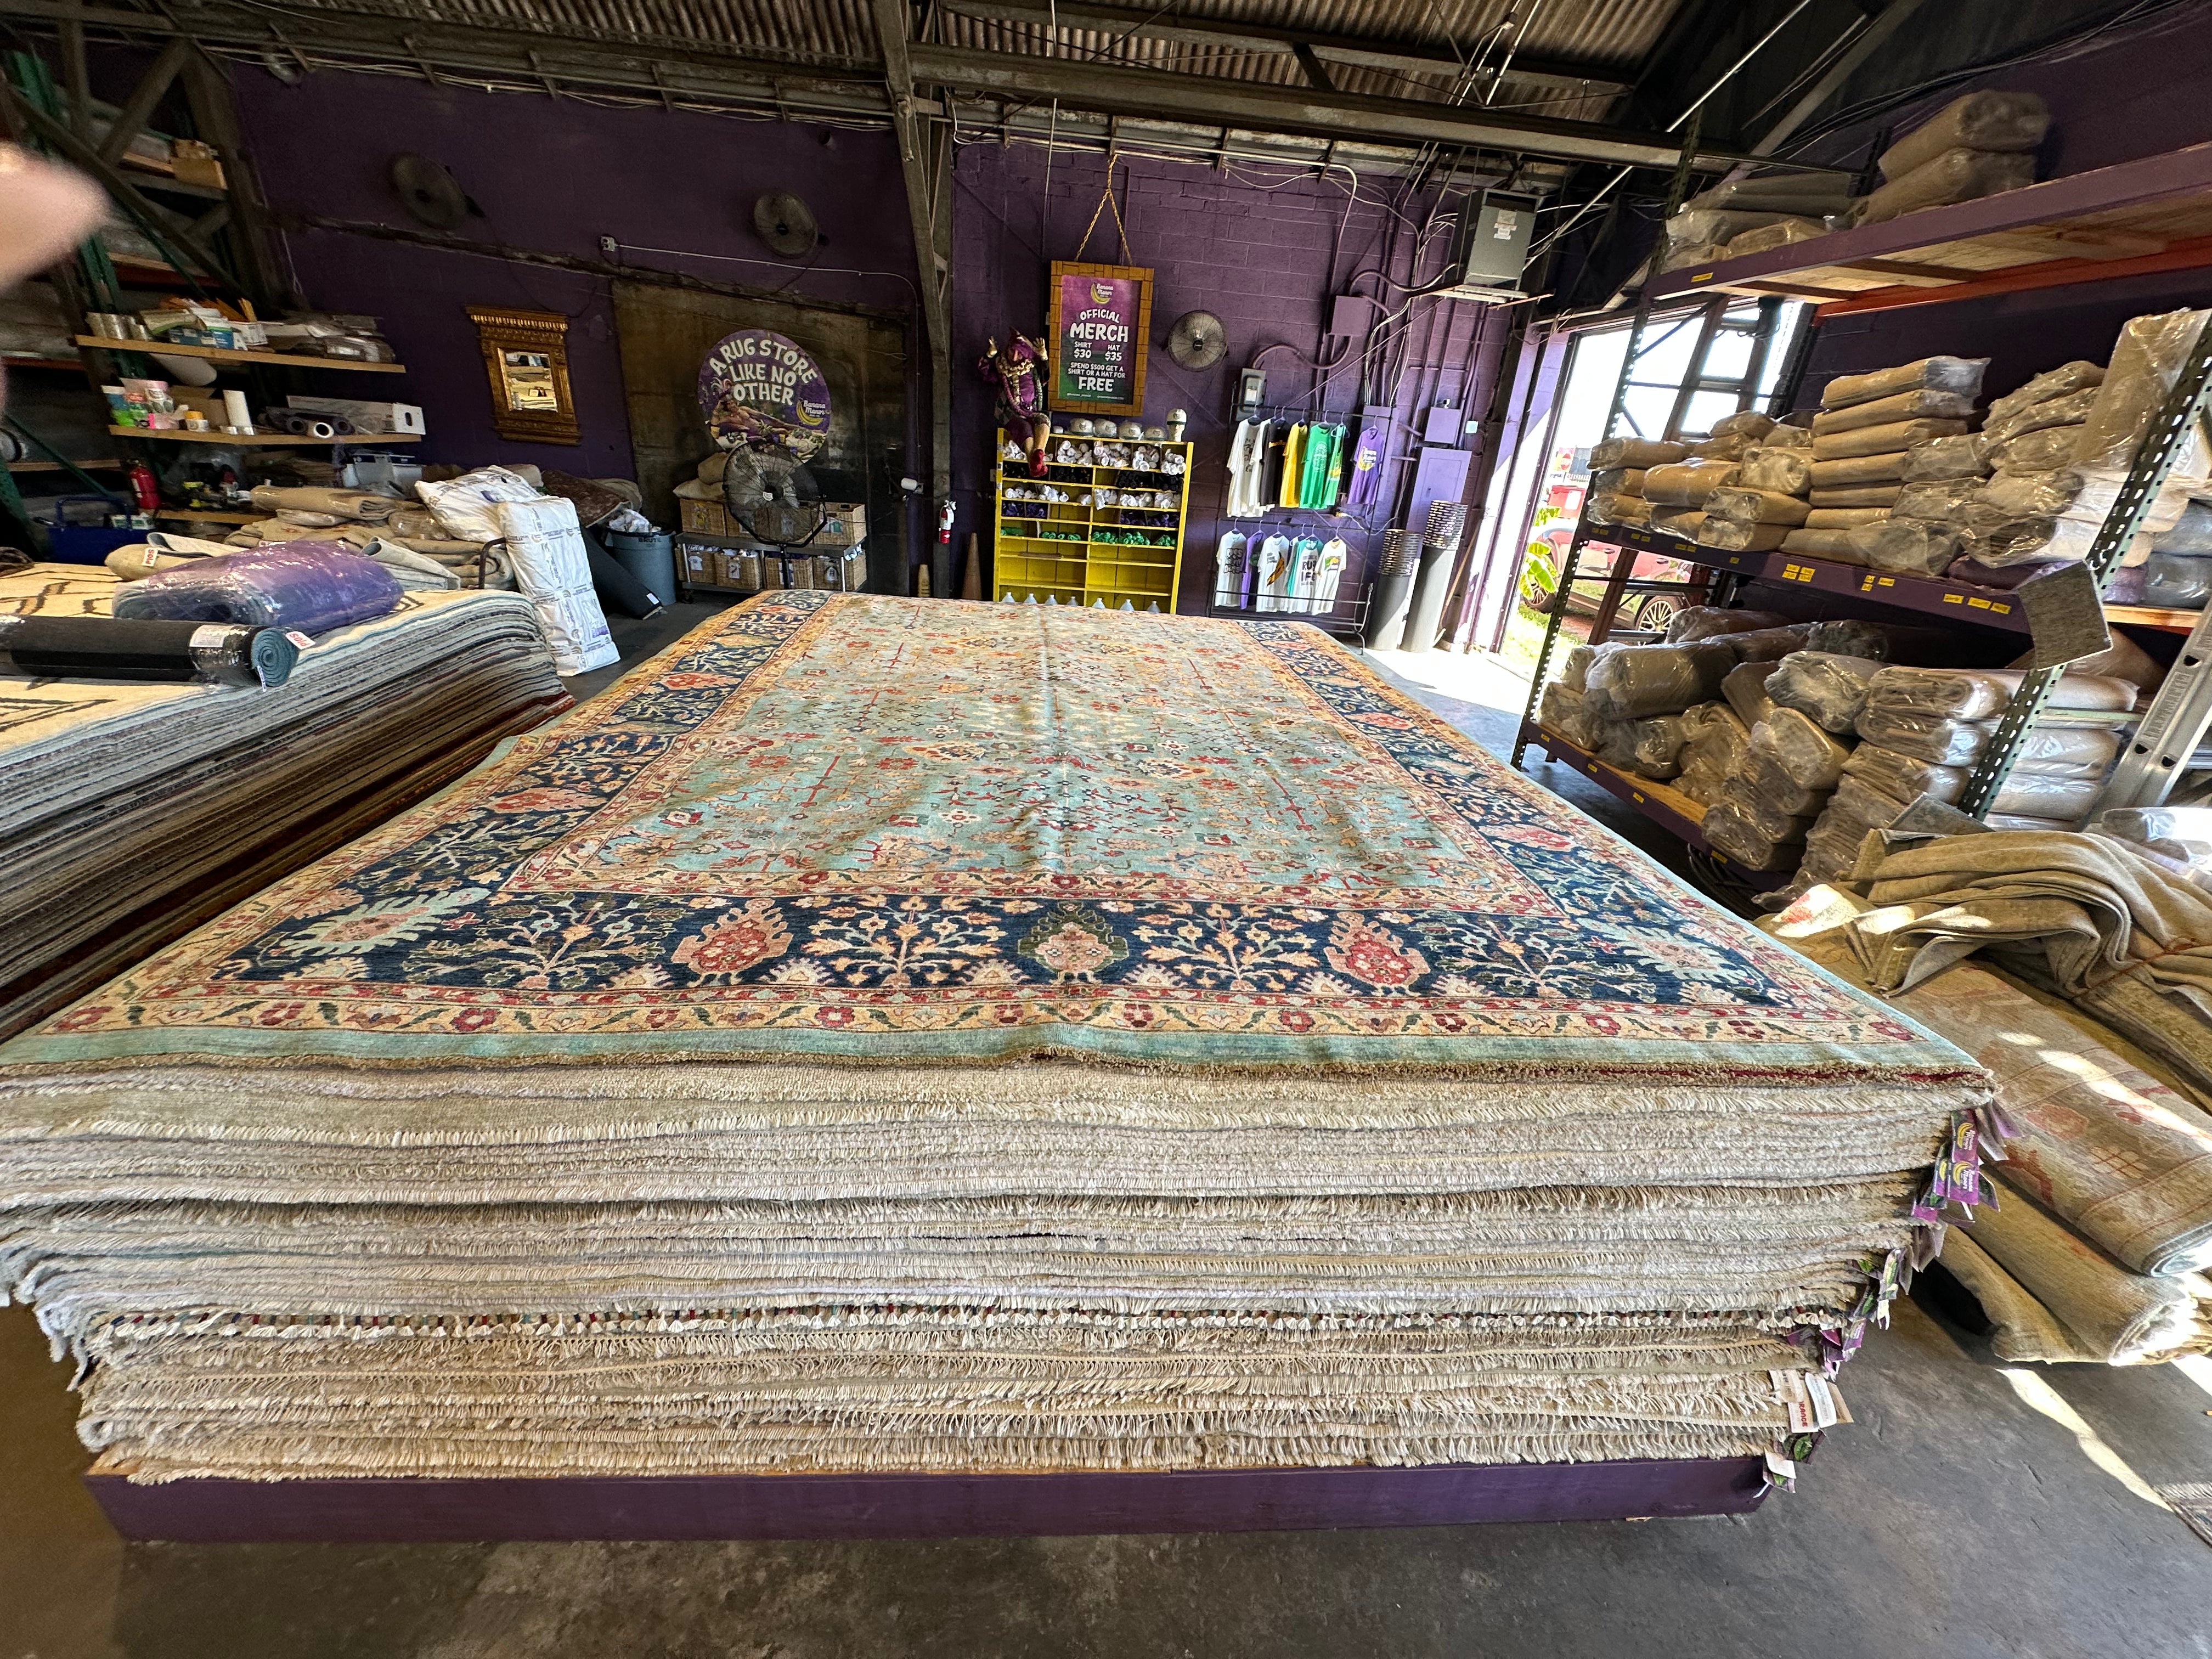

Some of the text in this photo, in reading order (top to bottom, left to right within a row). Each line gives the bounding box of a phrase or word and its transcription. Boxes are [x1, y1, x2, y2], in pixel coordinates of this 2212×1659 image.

[1080, 308, 1120, 324] OFFICIAL
[1070, 323, 1129, 342] MERCH
[709, 337, 817, 383] A RUG STORE
[1074, 348, 1092, 359] $30
[1105, 351, 1122, 362] $35
[729, 363, 797, 387] LIKE NO
[1078, 376, 1114, 392] FREE
[733, 382, 794, 405] OTHER
[805, 407, 825, 415] Manor
[289, 633, 311, 646] Sold
